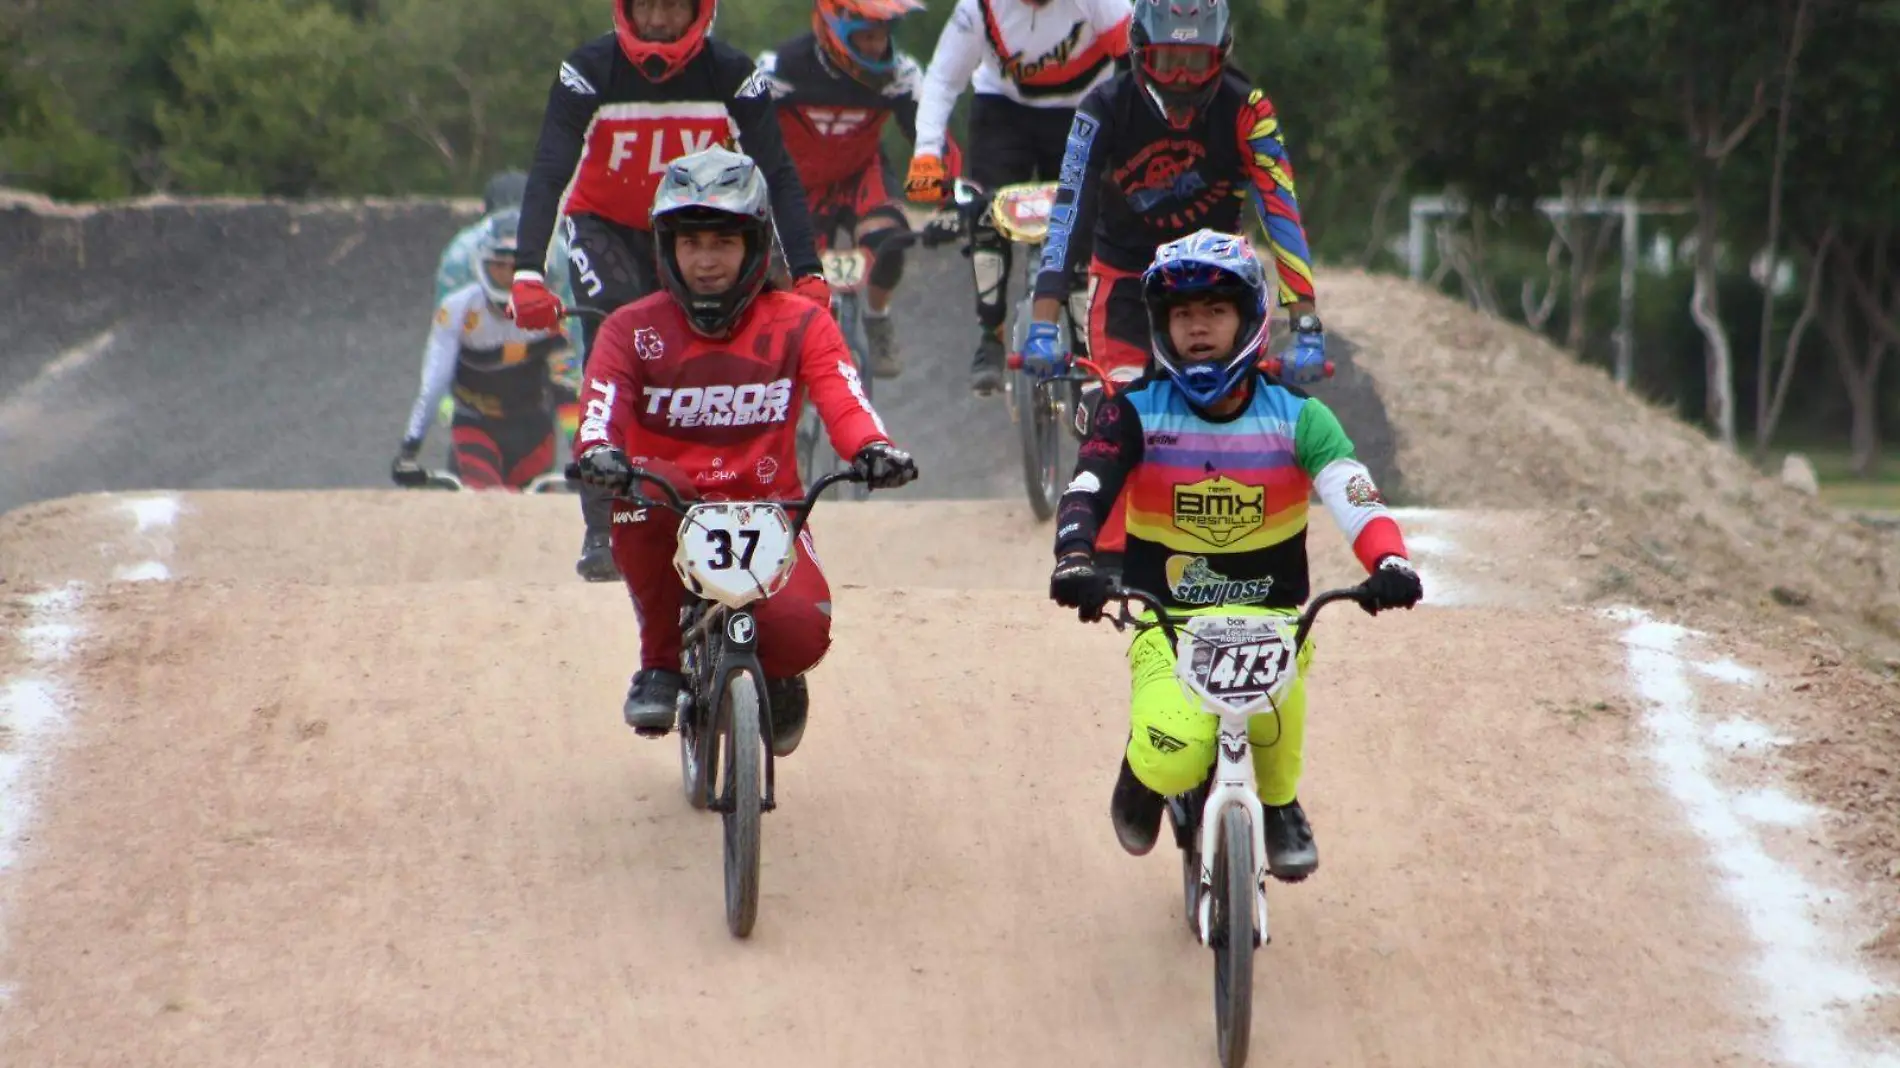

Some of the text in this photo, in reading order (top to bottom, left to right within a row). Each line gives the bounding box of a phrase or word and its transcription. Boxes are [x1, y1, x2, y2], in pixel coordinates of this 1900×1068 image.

[643, 378, 792, 414] TOROS
[696, 469, 737, 481] ALPHA
[1177, 492, 1262, 515] BMX
[1177, 514, 1261, 526] FRESNILLO
[706, 528, 760, 570] 37
[1210, 642, 1283, 689] 473
